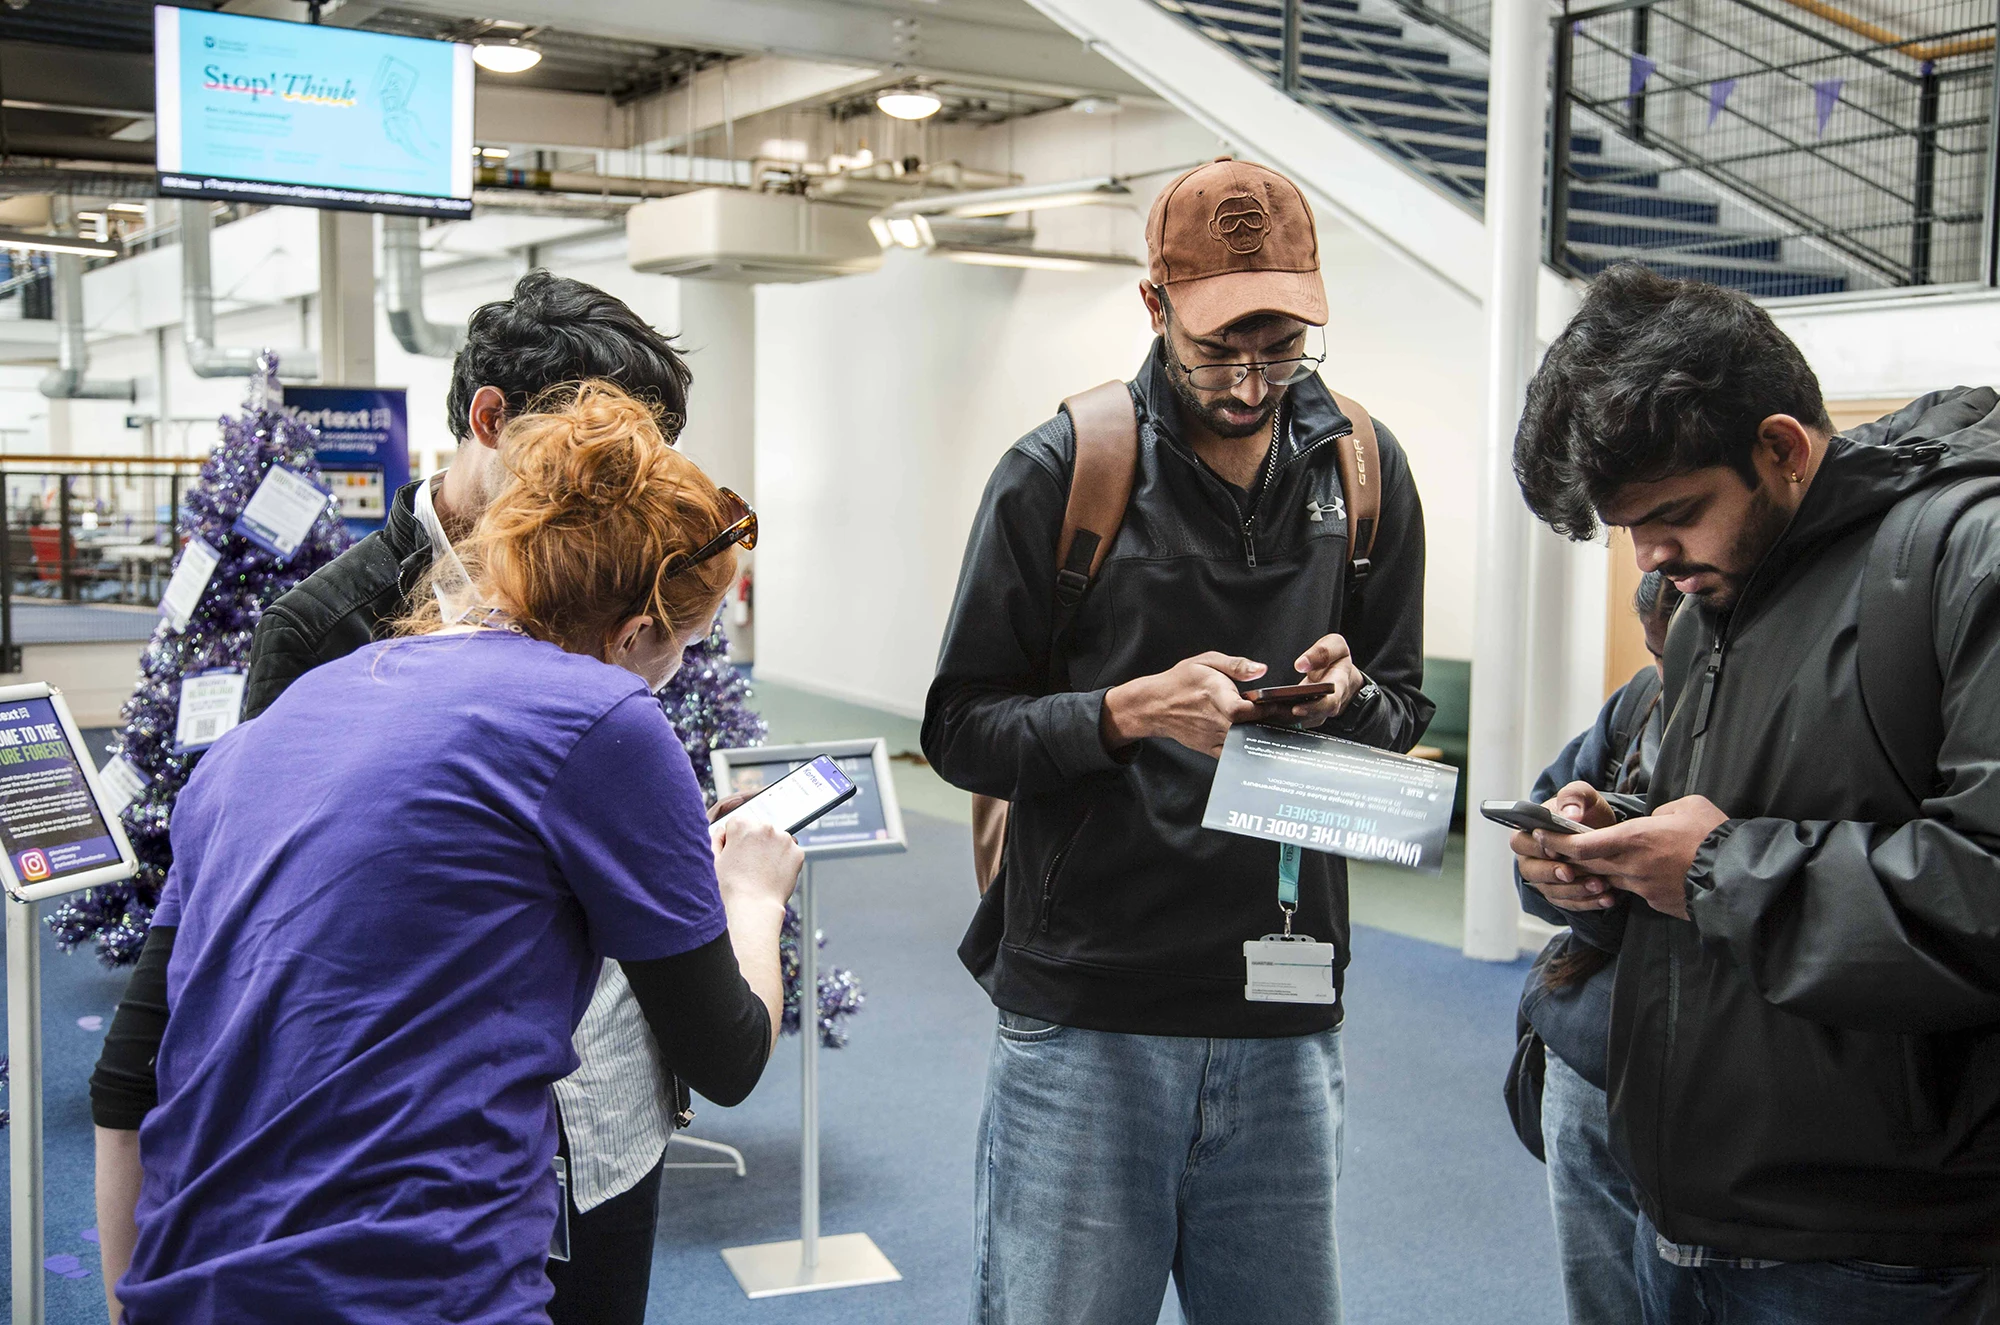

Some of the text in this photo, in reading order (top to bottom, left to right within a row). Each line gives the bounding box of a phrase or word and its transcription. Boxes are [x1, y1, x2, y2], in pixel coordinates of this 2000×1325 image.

[204, 64, 357, 102] Stop! Think
[1353, 438, 1366, 486] GEAR
[0, 708, 21, 721] ext
[18, 726, 38, 744] TO
[34, 723, 61, 742] THE
[0, 741, 69, 765] URE FOREST!
[1276, 803, 1378, 833] THE CLUESHEET
[1227, 810, 1422, 867] UNCOVER THE CODE LIVE
